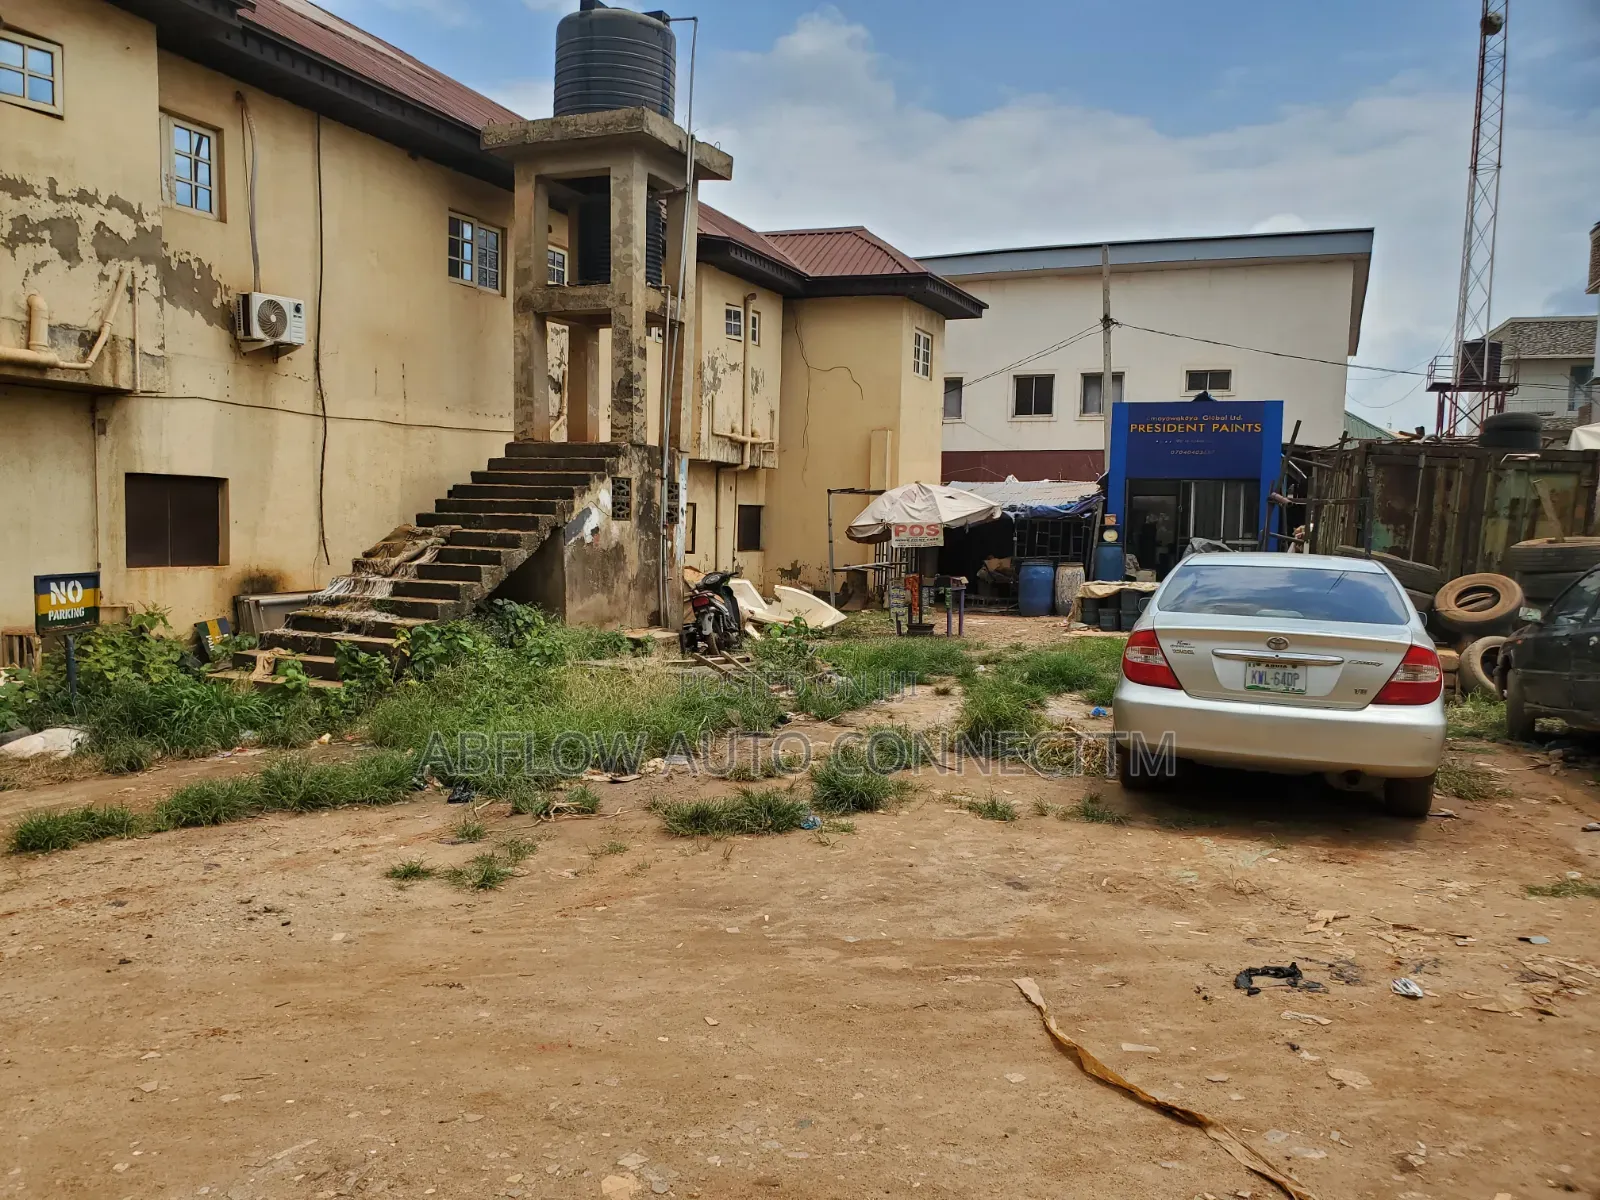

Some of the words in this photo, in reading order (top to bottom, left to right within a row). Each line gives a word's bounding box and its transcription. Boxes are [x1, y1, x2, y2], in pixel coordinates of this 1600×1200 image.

[1130, 423, 1206, 433] PRESIDENT
[1211, 423, 1262, 433] PAINTS
[894, 523, 940, 537] POS
[49, 579, 83, 606] NO
[48, 606, 85, 621] PARKING
